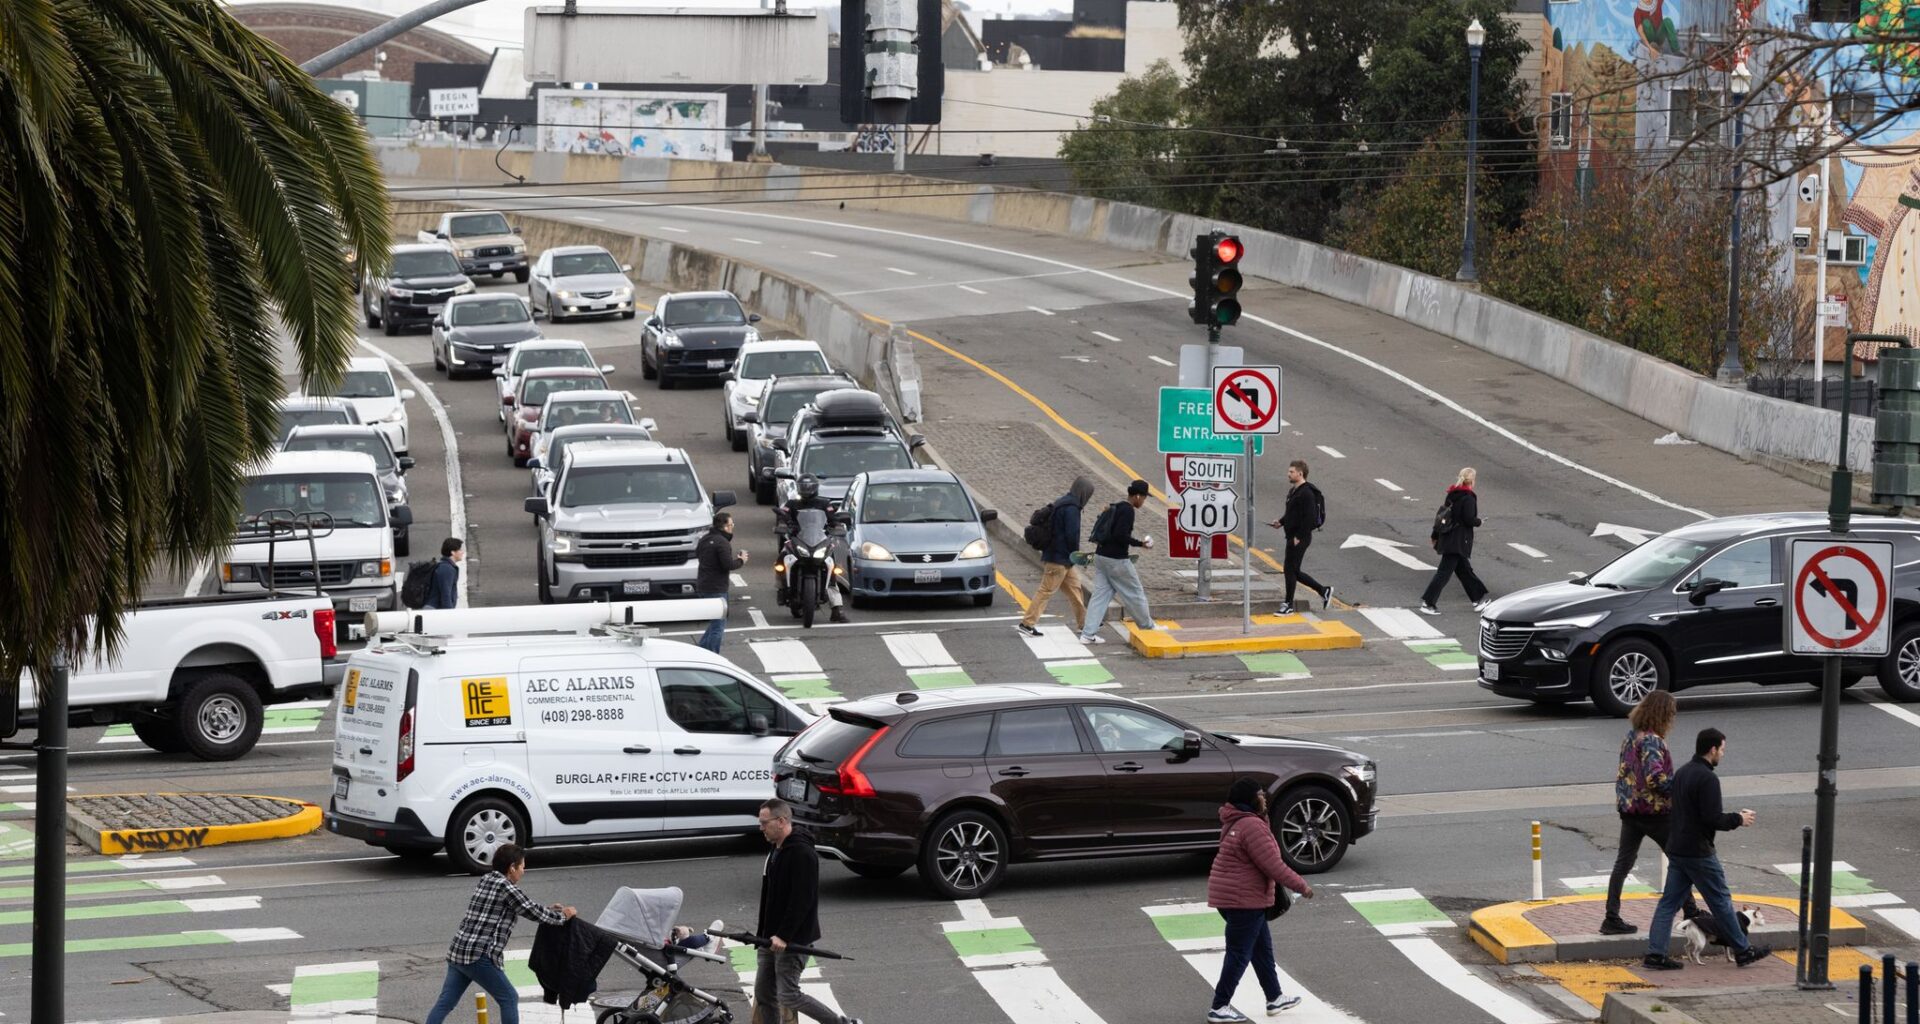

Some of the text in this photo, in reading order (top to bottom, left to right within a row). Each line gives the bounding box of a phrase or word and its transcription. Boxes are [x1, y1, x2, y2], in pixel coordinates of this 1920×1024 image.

[440, 93, 467, 101] BEGIN
[433, 103, 475, 111] FREEWAY
[1178, 402, 1212, 415] FREE
[1188, 461, 1233, 479] SOUTH
[1190, 504, 1228, 528] 101
[526, 676, 635, 693] AEC ALARMS
[527, 694, 635, 704] COMMERCIAL RESIDENTIAL
[469, 717, 508, 726] SINCE 1972
[541, 708, 625, 724] (408) 298-8888
[556, 773, 613, 784] BURGLAR
[621, 772, 647, 783] FIRE
[655, 771, 687, 782] CCTV
[695, 770, 728, 781] CARD
[449, 774, 532, 801] www.aec-alarms.com
